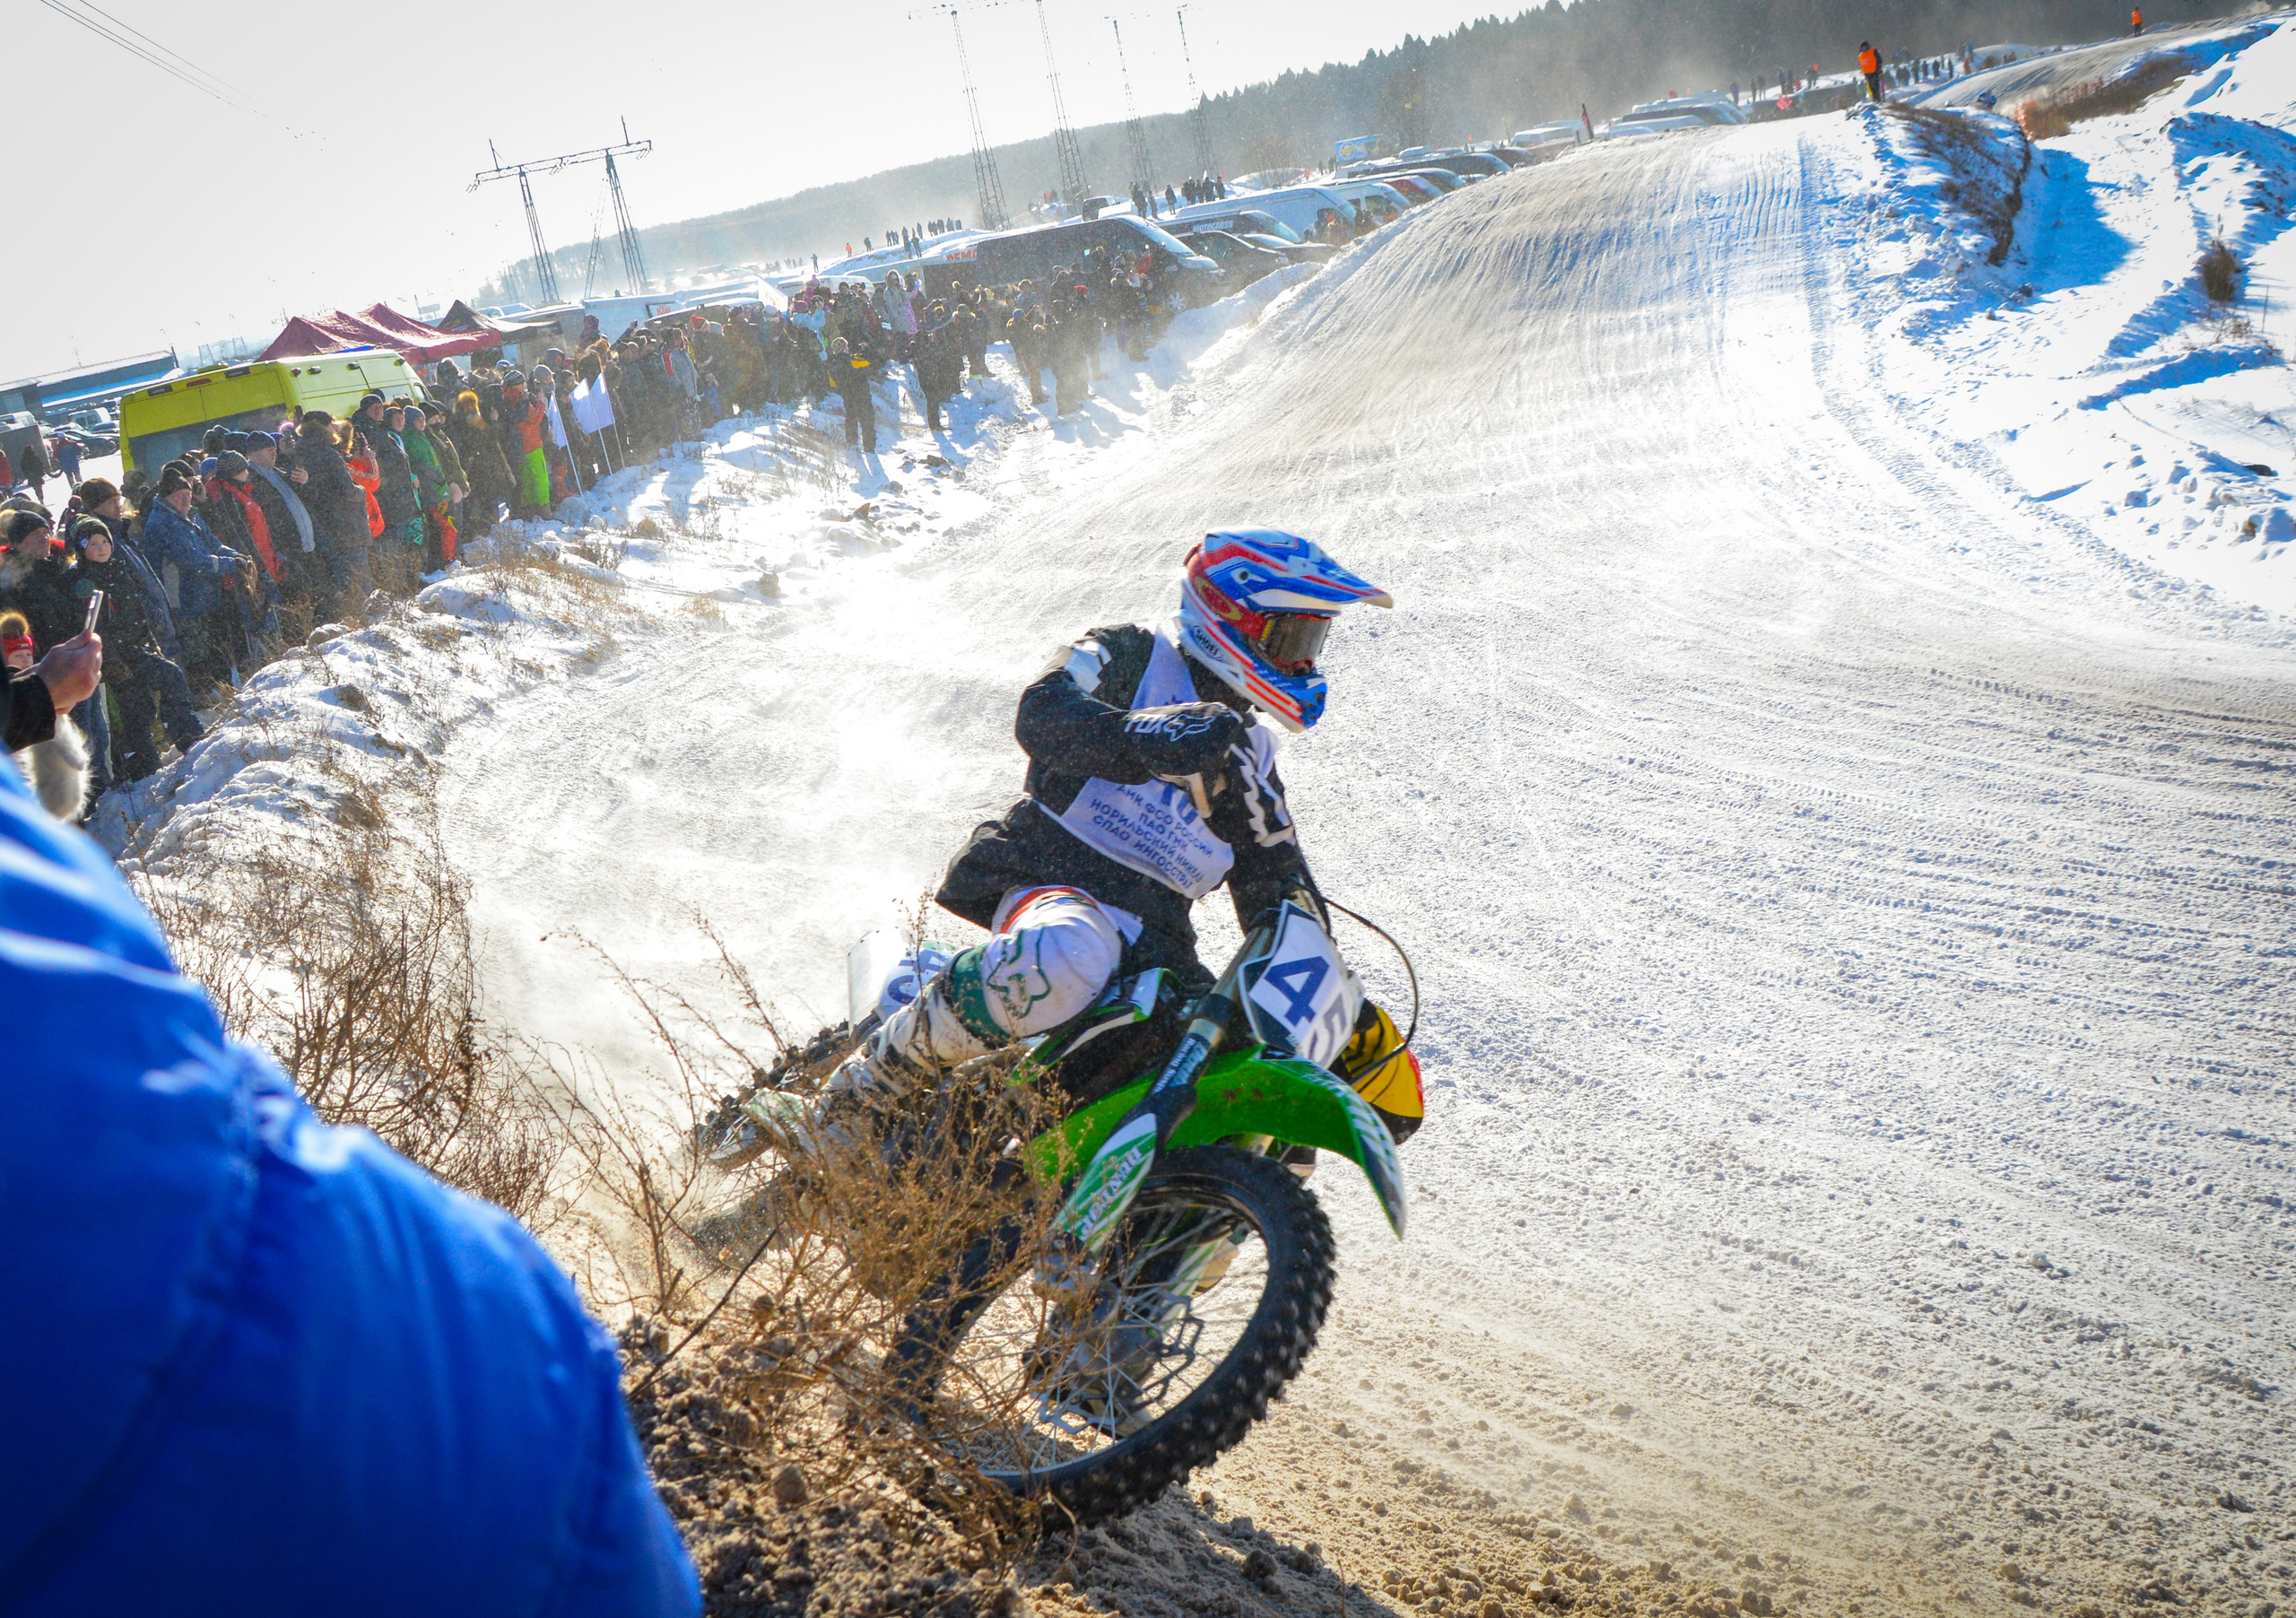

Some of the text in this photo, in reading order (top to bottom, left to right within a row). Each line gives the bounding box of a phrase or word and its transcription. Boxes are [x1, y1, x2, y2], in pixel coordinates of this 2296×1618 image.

[1090, 798, 1178, 857] НОРИЛЬСКИЙ
[1175, 854, 1204, 883] НИКЕЛЬ
[1092, 813, 1131, 841] СПАО
[1138, 813, 1189, 852] ПАО ГМК
[1144, 803, 1174, 826] ФСО
[1174, 823, 1213, 857] РОССИИ
